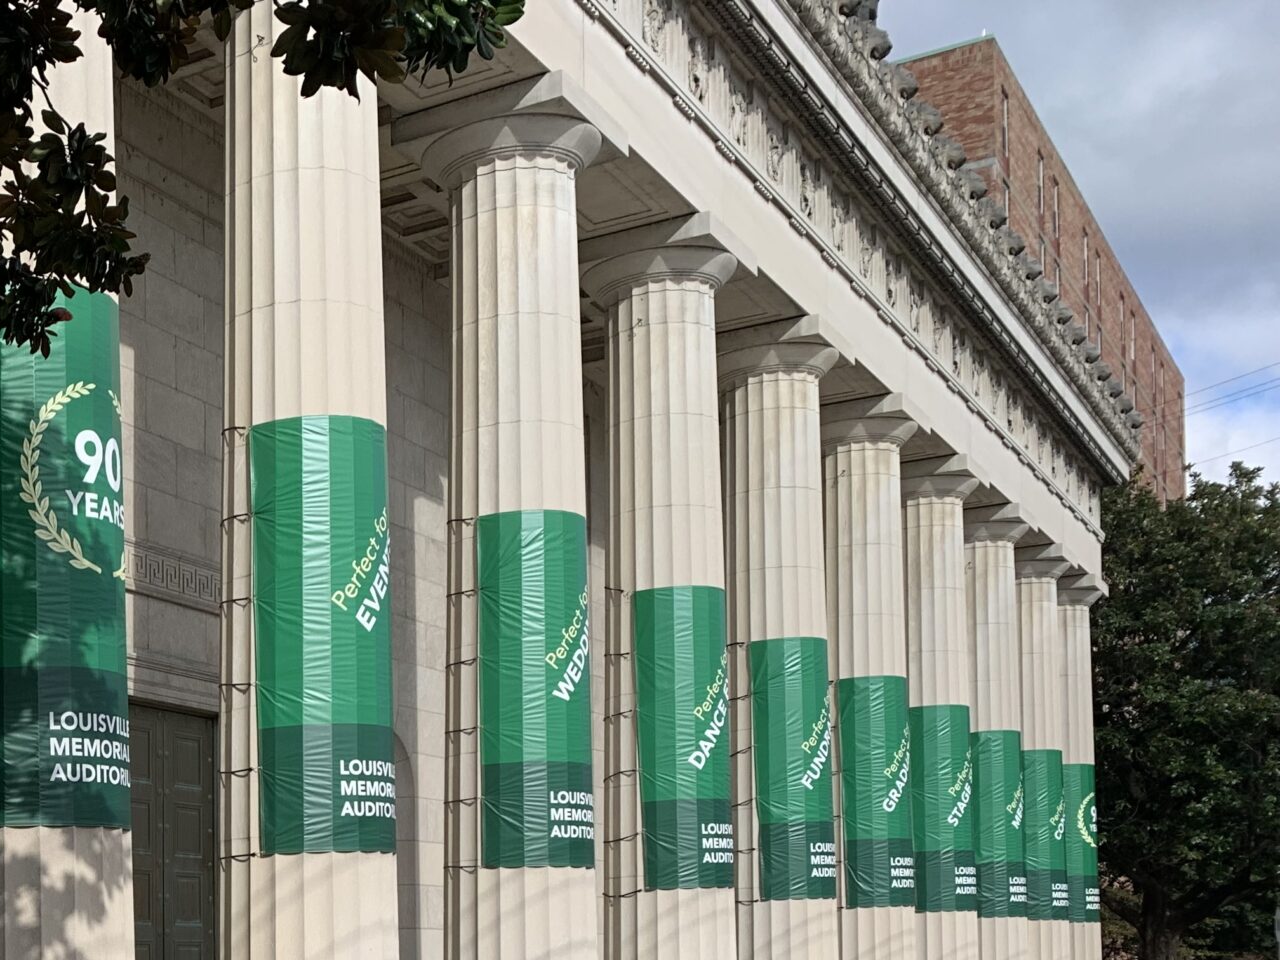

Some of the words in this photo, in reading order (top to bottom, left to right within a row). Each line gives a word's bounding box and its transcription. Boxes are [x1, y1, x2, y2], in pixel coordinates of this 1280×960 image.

[75, 429, 121, 493] 90
[65, 489, 125, 530] YEARS
[331, 537, 380, 611] Perfect
[375, 507, 387, 538] for
[545, 609, 583, 670] Perfect
[693, 668, 724, 721] Perfect
[688, 698, 727, 770] DANCE
[801, 708, 827, 754] Perfect
[884, 739, 906, 779] Perfect
[948, 761, 969, 797] Perfect
[947, 782, 971, 827] STAGE
